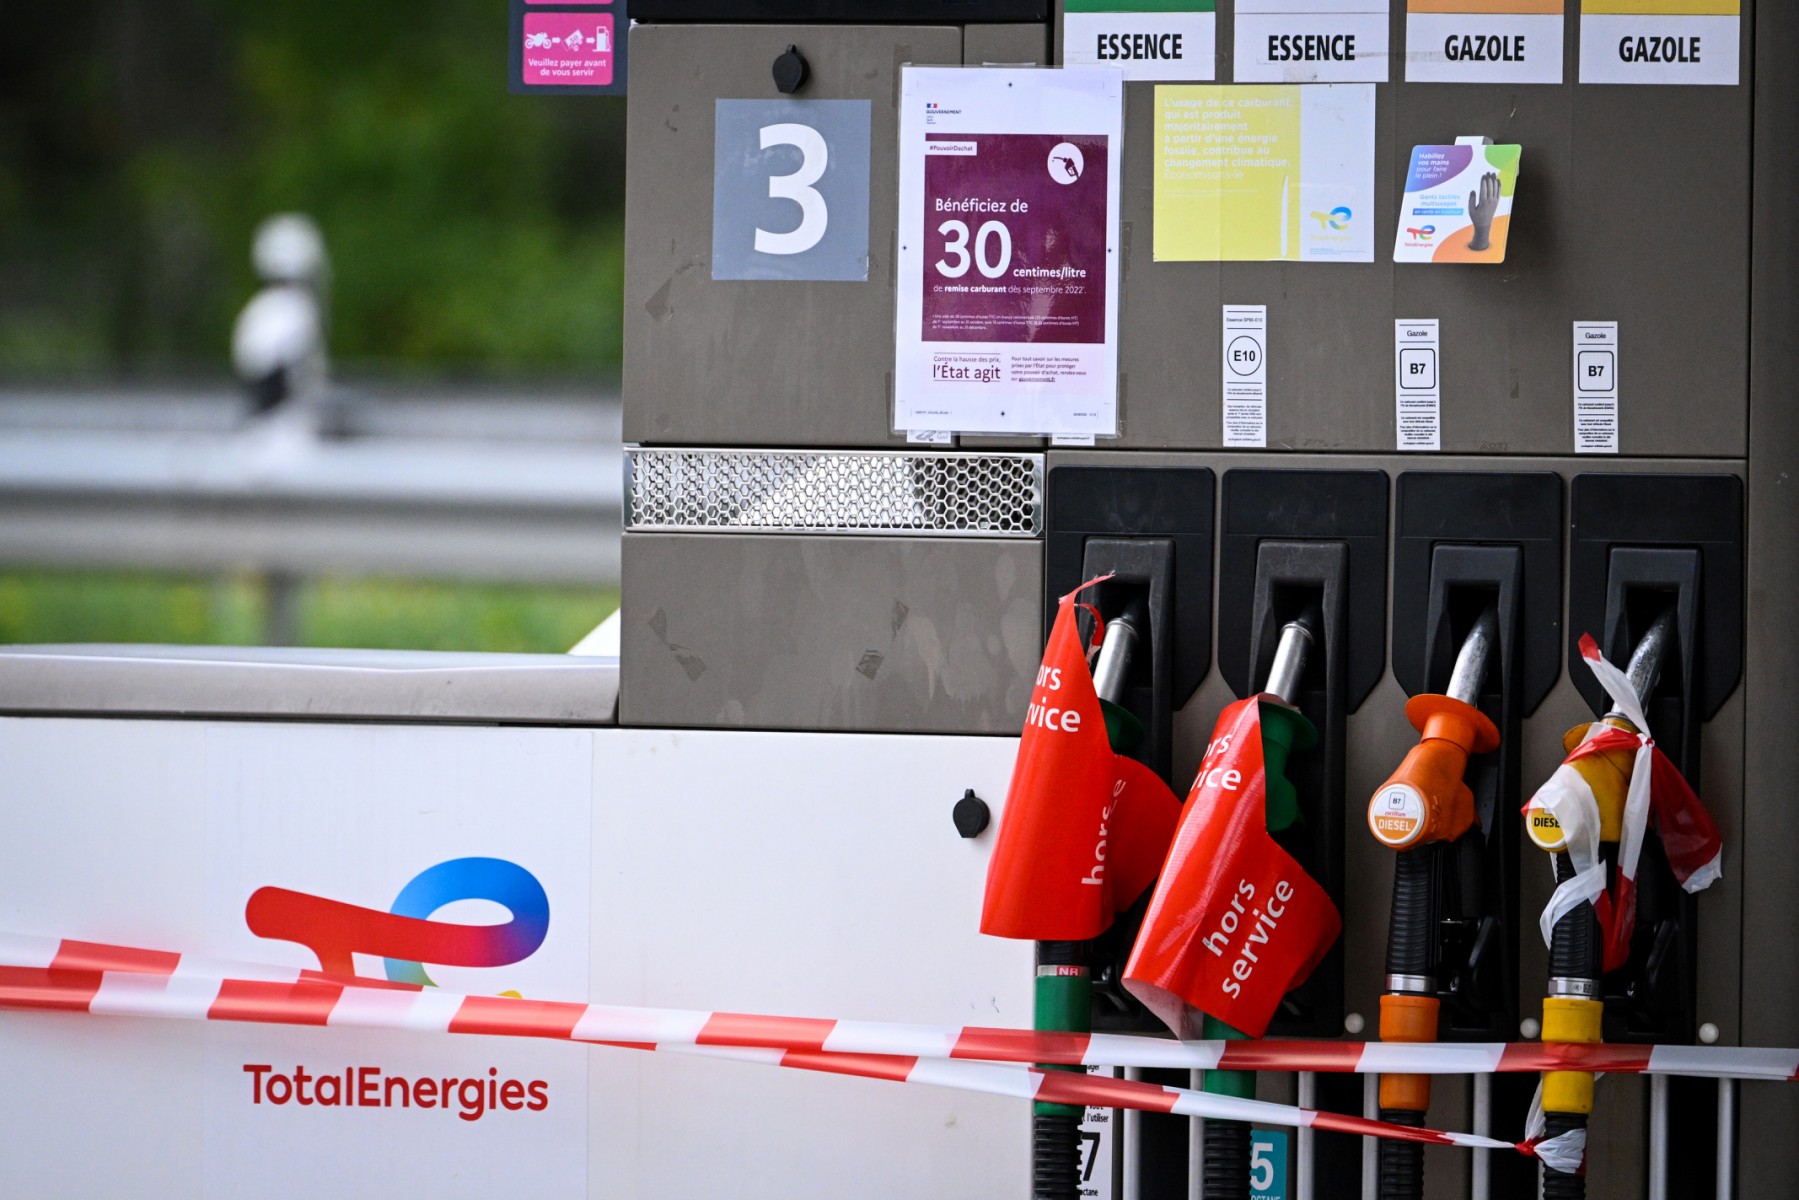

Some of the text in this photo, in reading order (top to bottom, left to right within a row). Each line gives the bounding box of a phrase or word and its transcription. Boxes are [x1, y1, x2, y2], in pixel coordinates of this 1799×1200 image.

[1097, 34, 1182, 60] ESSENCE
[1268, 35, 1355, 61] ESSENCE
[1444, 35, 1525, 61] GAZOLE
[1619, 36, 1700, 62] GAZOLE
[560, 60, 582, 68] payer
[572, 68, 593, 76] servir
[1165, 98, 1202, 109] L'usage
[1207, 98, 1218, 107] de
[1166, 110, 1242, 120] qui est produit
[1165, 122, 1248, 133] majoritairement
[1174, 134, 1202, 144] partir
[1206, 133, 1234, 142] d'une
[1238, 133, 1278, 144] énergie
[1203, 145, 1254, 155] contribue
[1165, 158, 1228, 168] changement
[754, 122, 828, 254] 3
[936, 198, 1028, 212] Bénéficiez de
[935, 220, 1086, 279] 30 centimes/litre
[934, 284, 943, 292] de
[944, 284, 968, 292] remise
[970, 285, 1006, 293] carburant
[1008, 285, 1021, 293] dès
[1023, 286, 1063, 295] septembre
[1234, 350, 1256, 362] E10
[974, 365, 1000, 383] agit
[1410, 363, 1426, 374] B7
[1588, 366, 1604, 376] B7
[1036, 665, 1061, 690] ors
[1379, 819, 1411, 831] DIESEL
[1534, 817, 1560, 828] DIESE
[1202, 878, 1255, 957] hors
[1222, 880, 1294, 1000] service
[243, 1064, 548, 1121] TotalEnergies
[1087, 1113, 1109, 1122] l'utiliser
[1082, 1132, 1100, 1181] 7
[1250, 1142, 1273, 1190] 5
